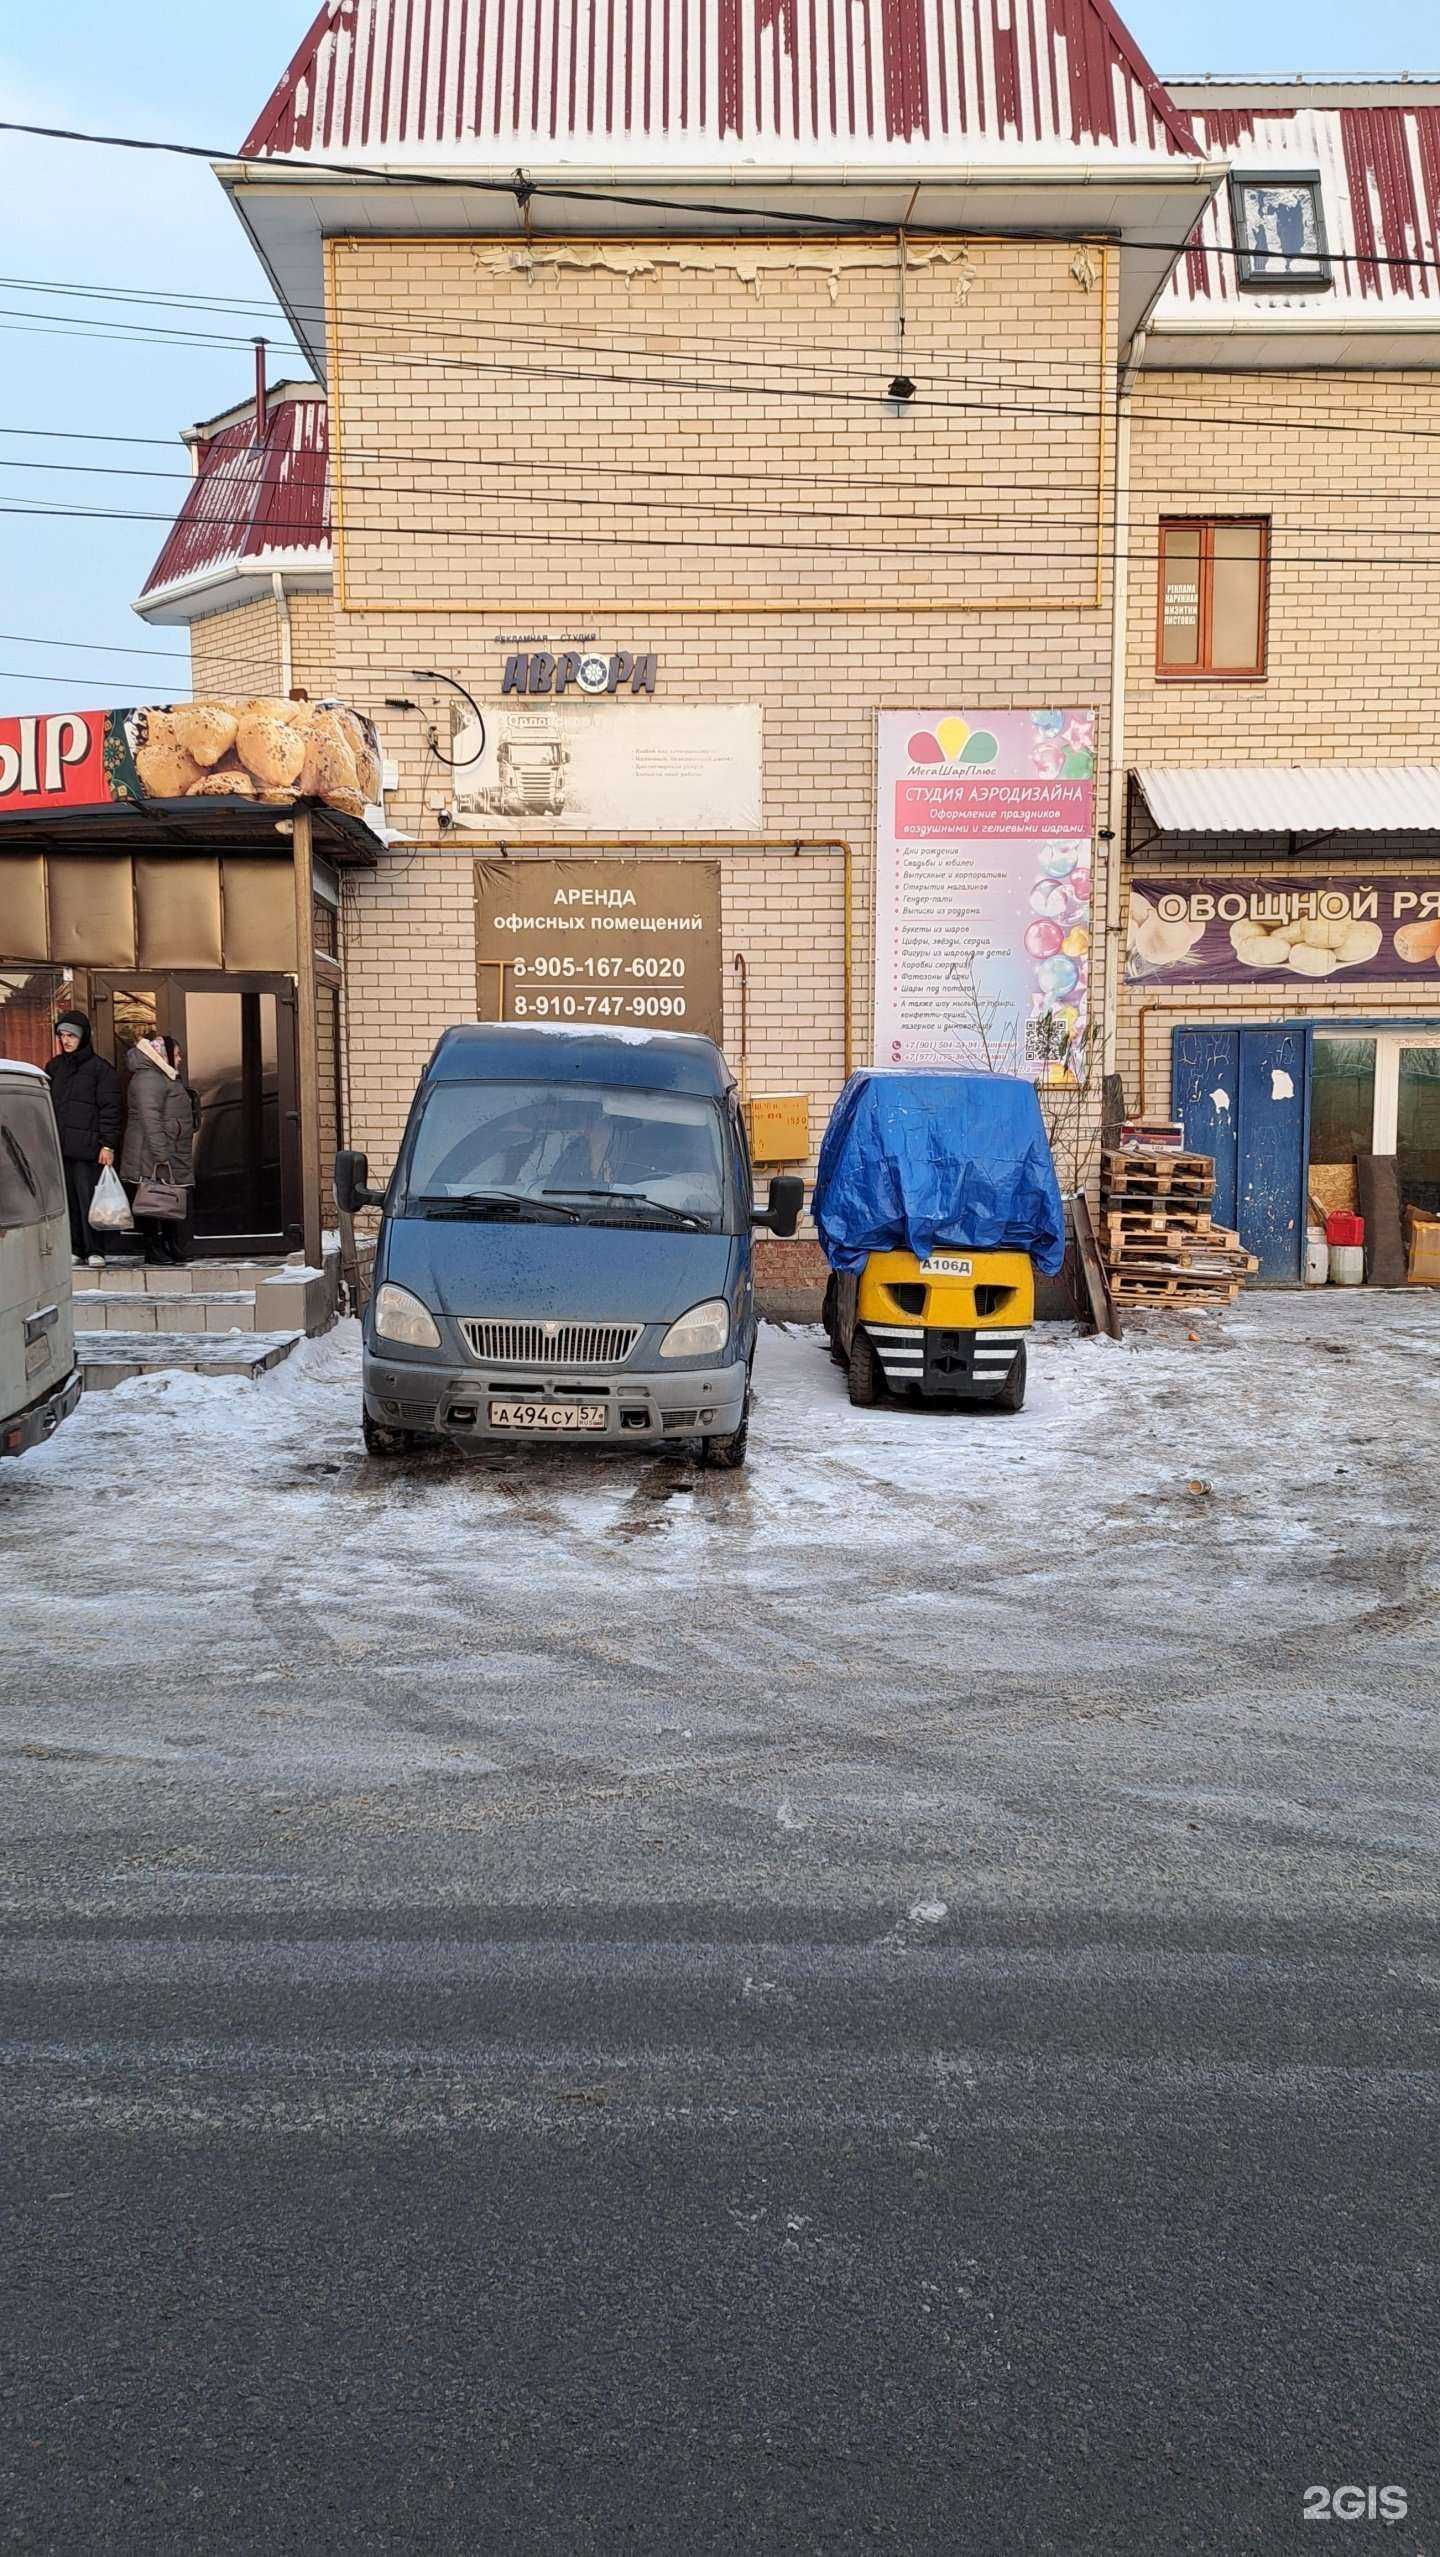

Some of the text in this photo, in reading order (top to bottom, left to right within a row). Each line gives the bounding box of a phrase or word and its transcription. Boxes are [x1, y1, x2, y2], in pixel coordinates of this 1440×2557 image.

[494, 633, 596, 644] РЕКЛАМНАЯ СТУДИЯ
[502, 650, 658, 694] АВРОРА
[907, 766, 998, 778] МегаШарПлюс
[906, 784, 1083, 803] СТУДИЯ АЭРОДИЗАЙНА
[930, 808, 1060, 822] Оформление праздников
[904, 824, 969, 837] воздушными
[982, 825, 1038, 834] гелиевыми
[1040, 825, 1086, 836] шарами.
[553, 888, 637, 908] АРЕНДА
[1157, 886, 1379, 925] ОВОЩНОЙ
[494, 914, 703, 933] офисных помещений
[513, 957, 686, 978] 8-905-167-6020
[514, 996, 686, 1016] 8-910-747-9090
[922, 1259, 970, 1274] А106Д
[499, 1406, 598, 1425] А494СУ 57
